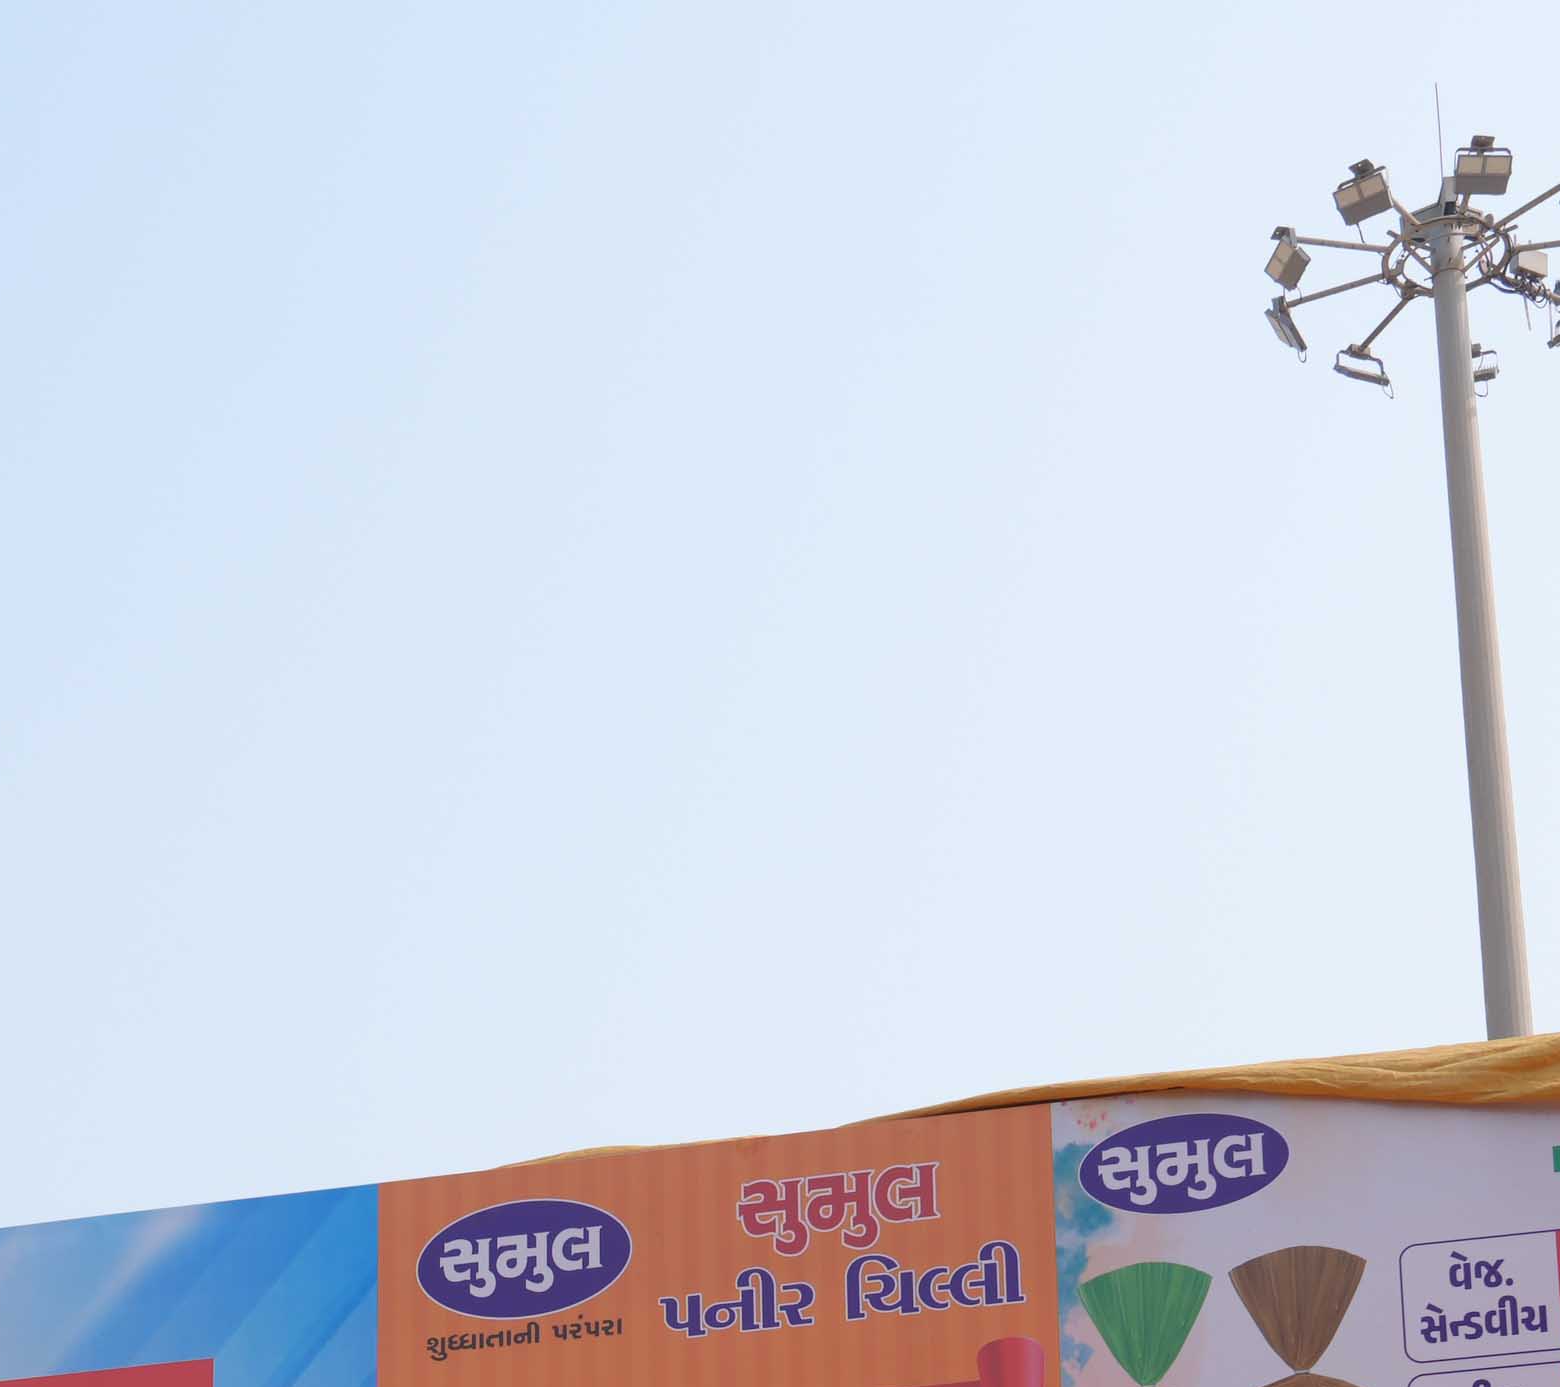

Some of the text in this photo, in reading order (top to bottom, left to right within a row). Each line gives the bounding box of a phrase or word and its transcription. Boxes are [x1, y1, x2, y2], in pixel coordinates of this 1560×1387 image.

[1096, 1131, 1268, 1204] સુમુલ
[737, 1161, 940, 1256] સુમુલ
[439, 1225, 603, 1297] સુમુલ
[659, 1240, 1026, 1338] પનીર ચિલ્લી
[1448, 1251, 1515, 1290] વેજ.
[1420, 1304, 1549, 1344] સેન્ડવીચ
